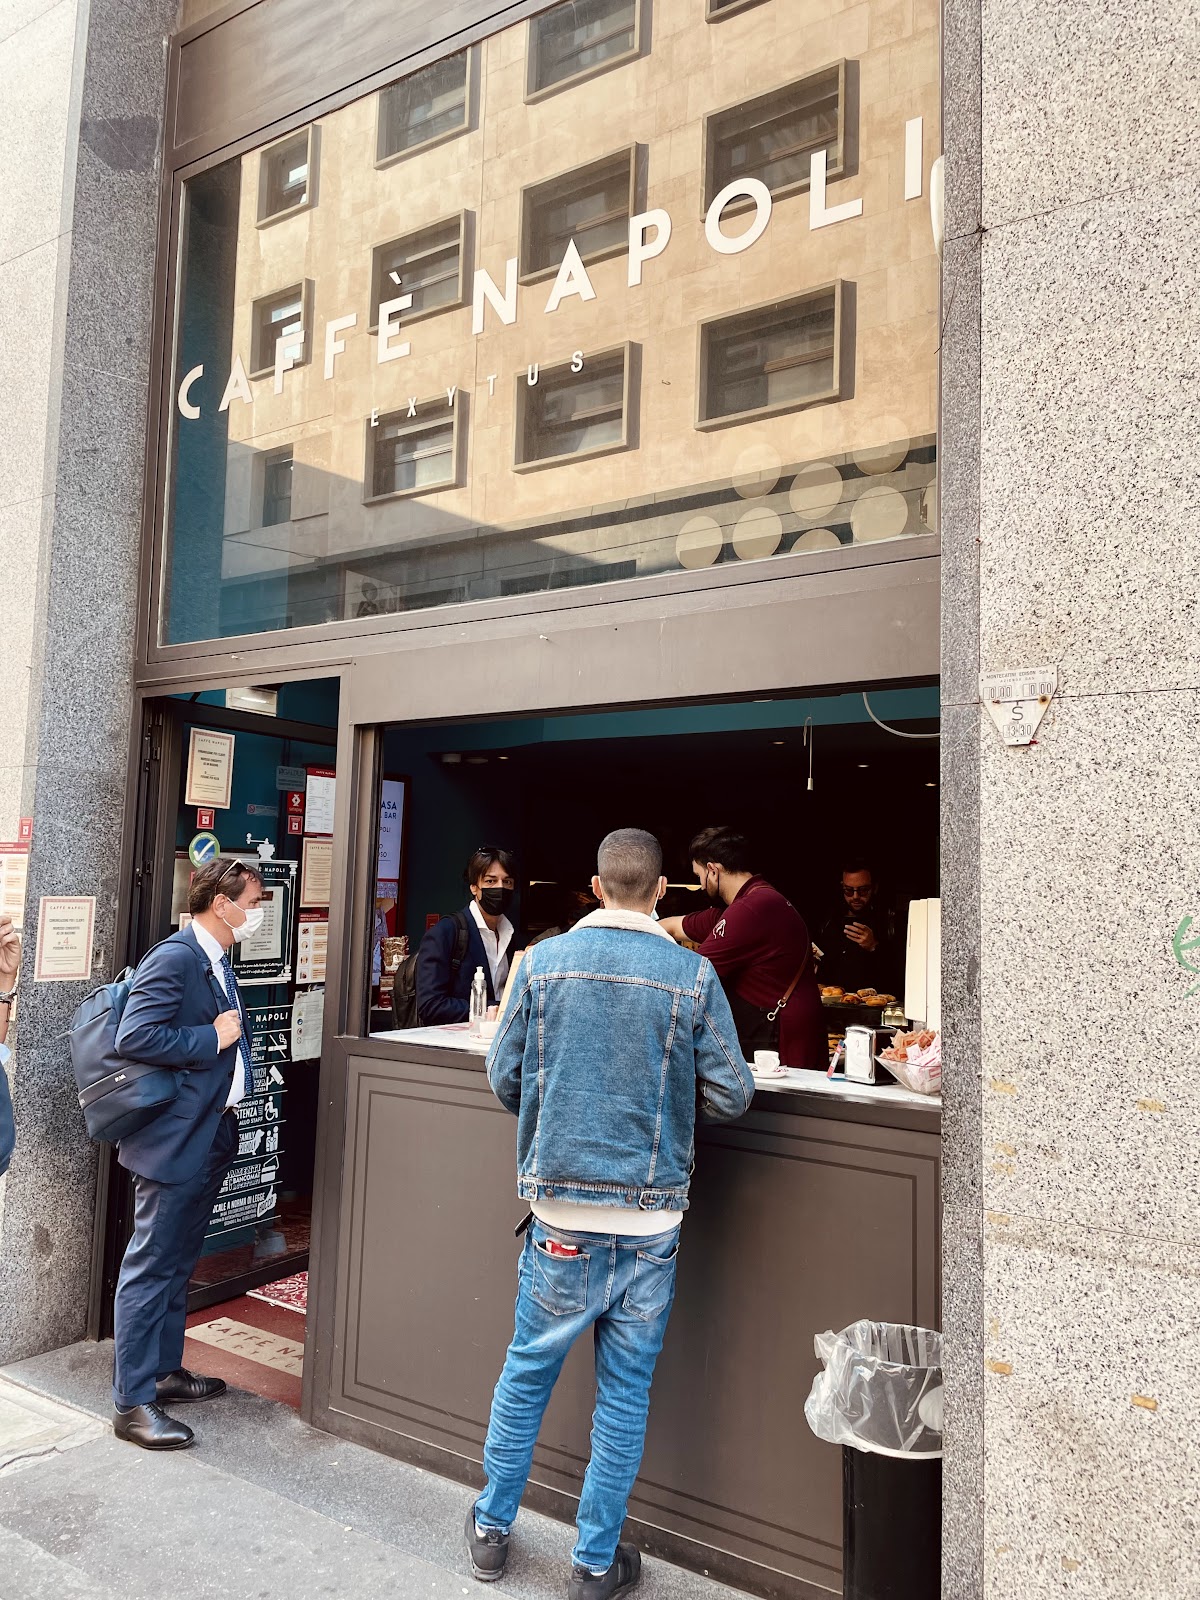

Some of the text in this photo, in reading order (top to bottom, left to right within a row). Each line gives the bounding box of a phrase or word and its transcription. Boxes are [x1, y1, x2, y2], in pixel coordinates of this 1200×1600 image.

[177, 117, 923, 421] CAFFÈ NAPOLI
[370, 350, 583, 427] EXYTUS
[1012, 706, 1024, 722] S
[384, 811, 397, 820] BAR
[255, 1012, 288, 1023] NAPOLI
